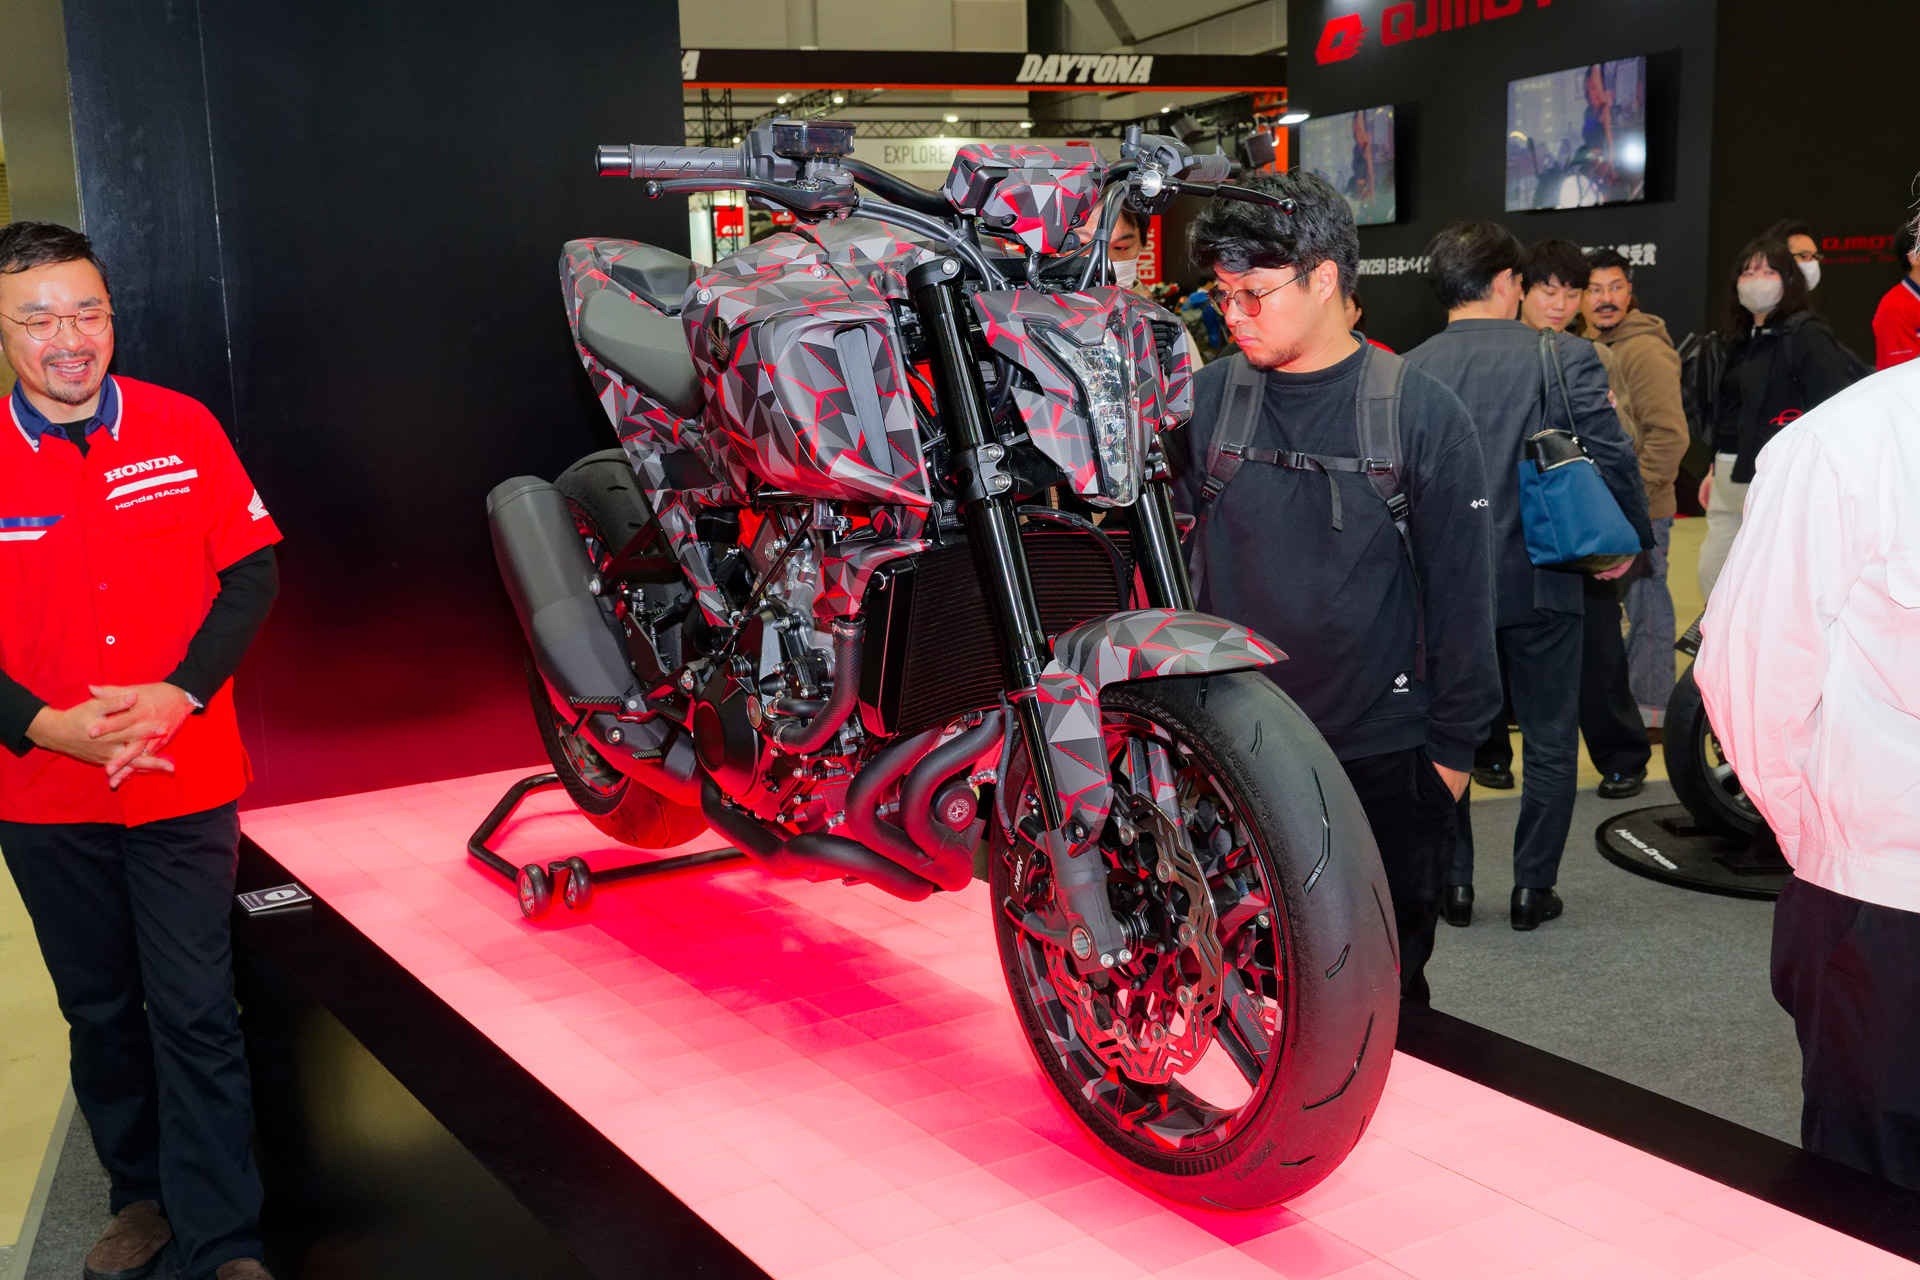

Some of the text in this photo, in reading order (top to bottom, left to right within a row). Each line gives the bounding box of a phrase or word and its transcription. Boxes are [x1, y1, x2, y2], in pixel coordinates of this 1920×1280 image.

[1016, 54, 1154, 84] DAYTONA
[103, 455, 184, 483] HONDA
[115, 486, 190, 510] Honda RACING
